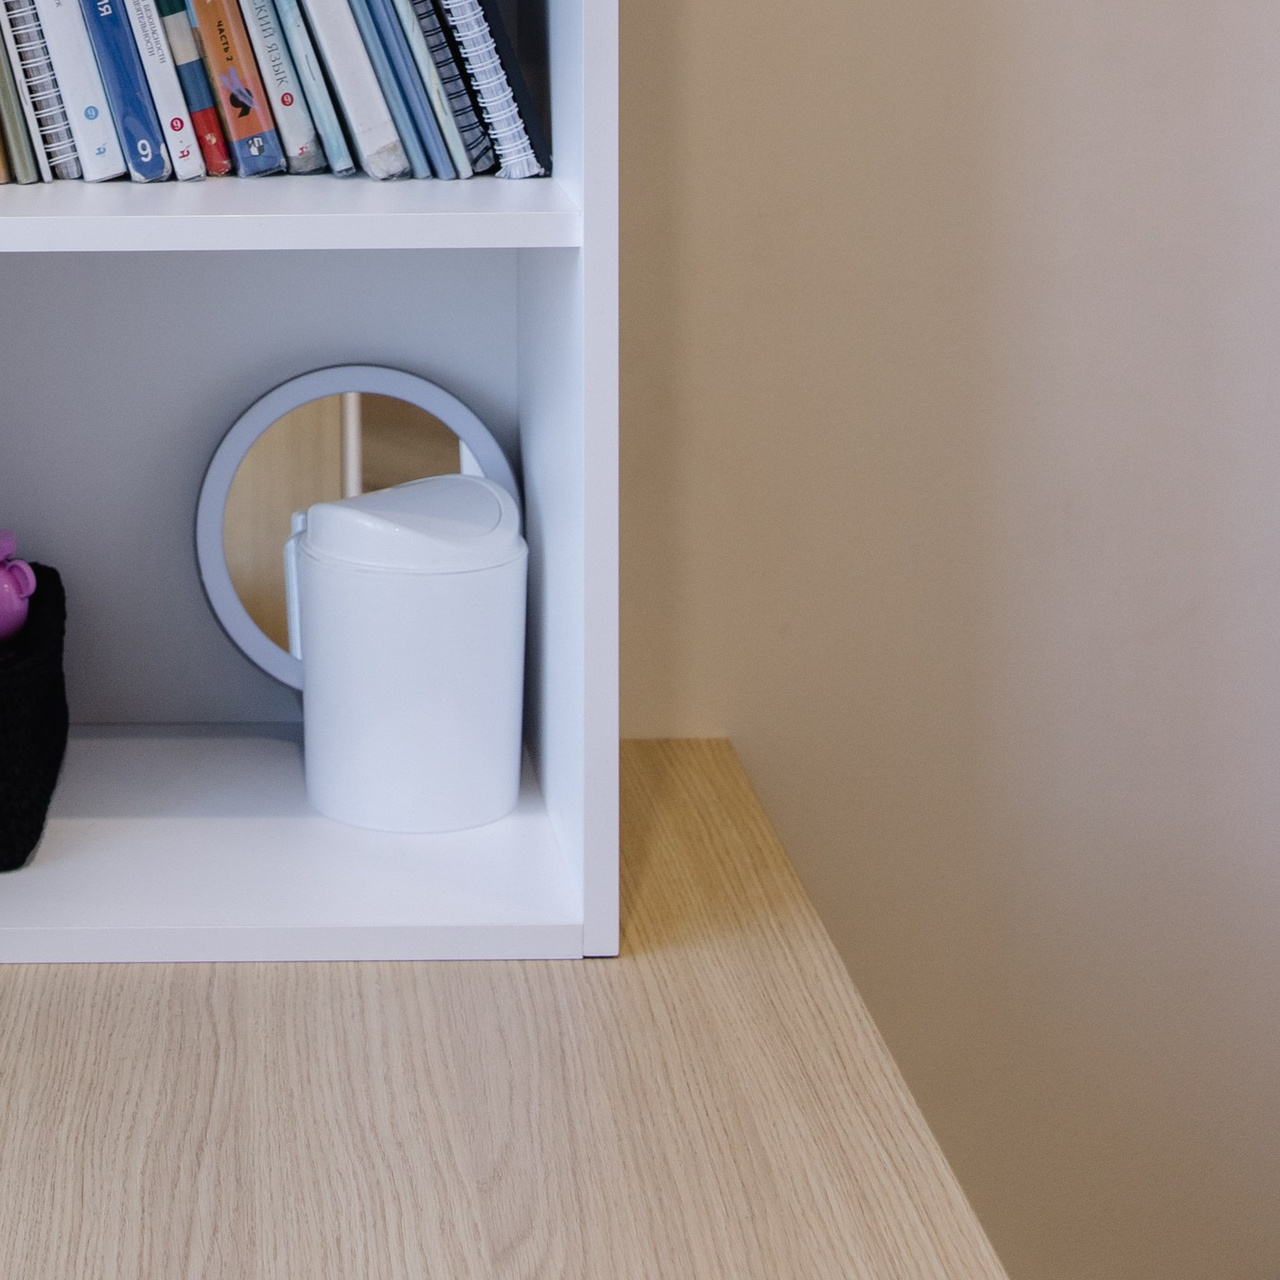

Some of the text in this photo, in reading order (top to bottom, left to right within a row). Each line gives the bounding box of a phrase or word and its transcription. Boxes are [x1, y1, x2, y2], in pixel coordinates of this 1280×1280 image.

[143, 3, 167, 64] БЕЗОПАСНОСТИ
[215, 20, 234, 63] ЧАСТЬ 2
[266, 42, 289, 88] ЯЗЫК
[136, 139, 153, 163] 9
